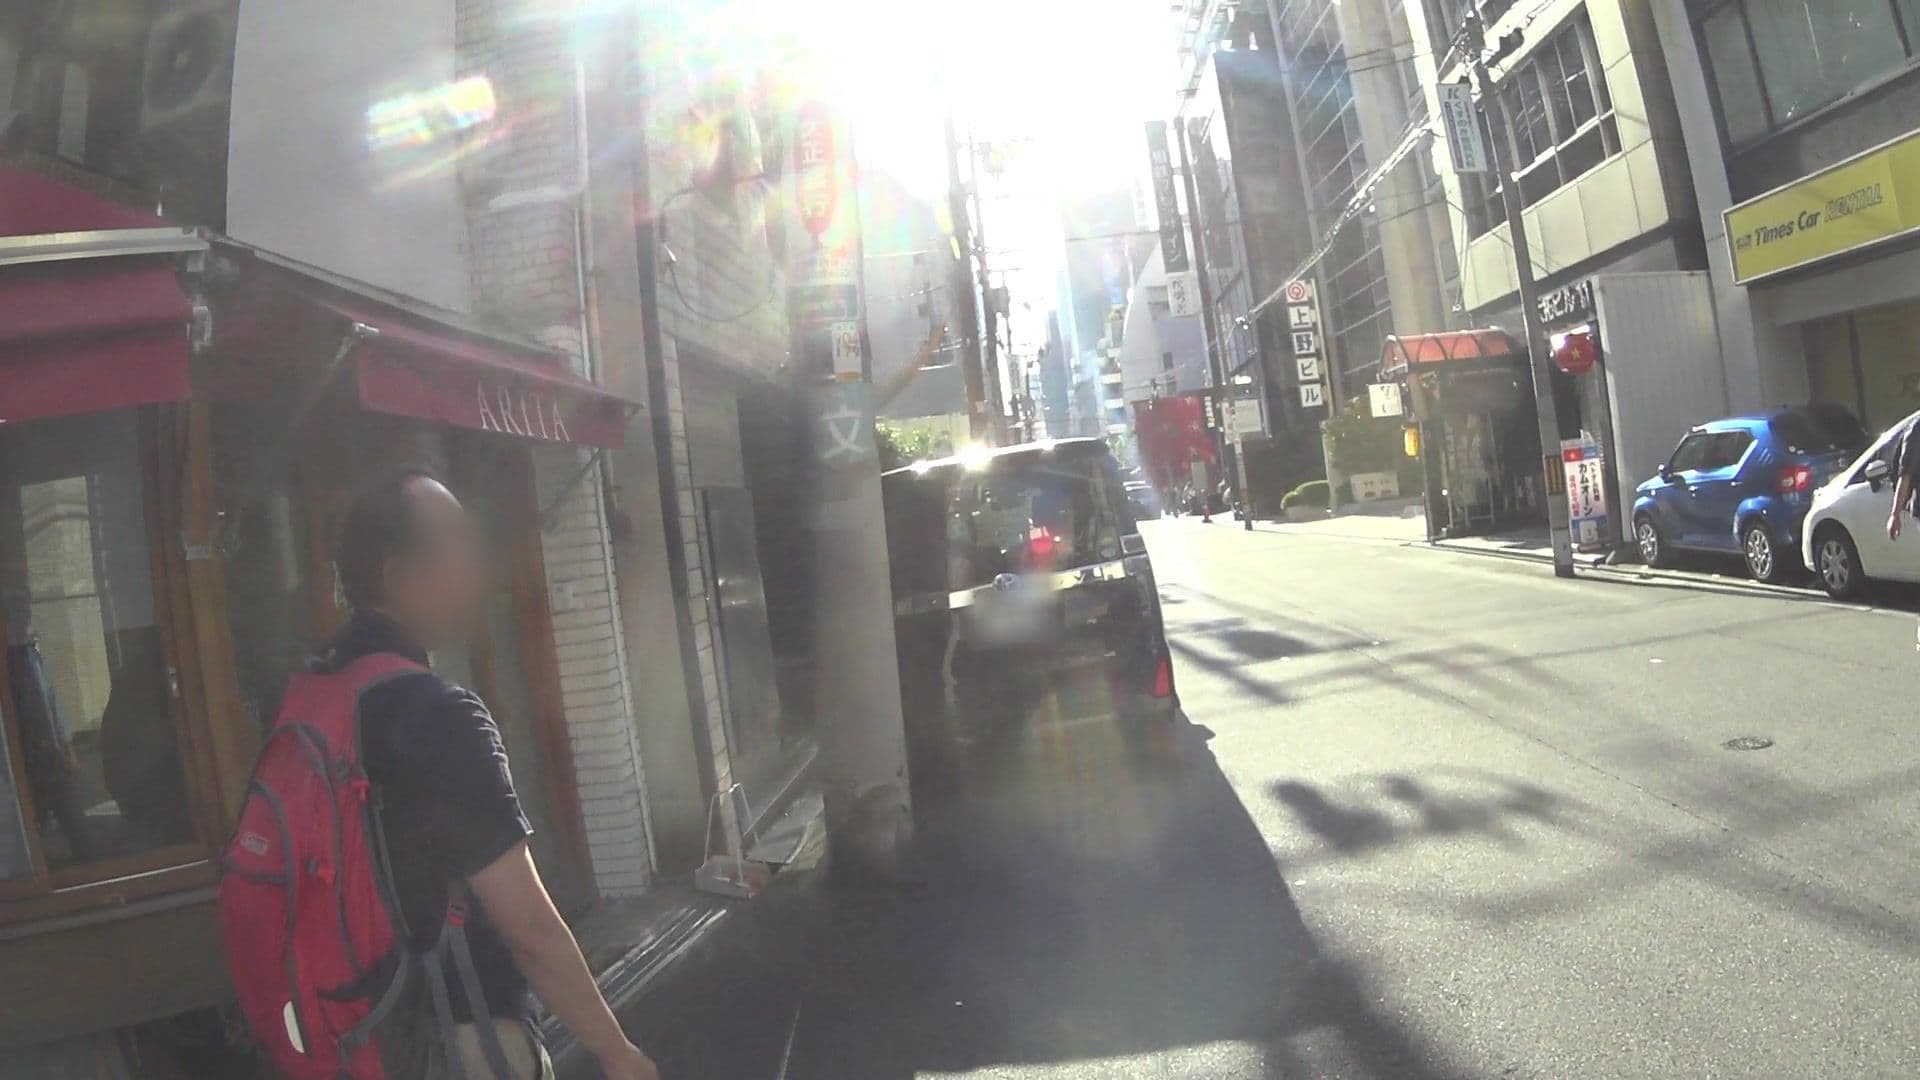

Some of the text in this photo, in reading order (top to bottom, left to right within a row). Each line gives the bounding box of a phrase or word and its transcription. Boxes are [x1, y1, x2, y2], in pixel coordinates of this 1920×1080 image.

[1754, 220, 1794, 247] Times
[1797, 210, 1821, 231] Car
[478, 383, 570, 442] ARITA
[1578, 463, 1592, 516] カムオーン
